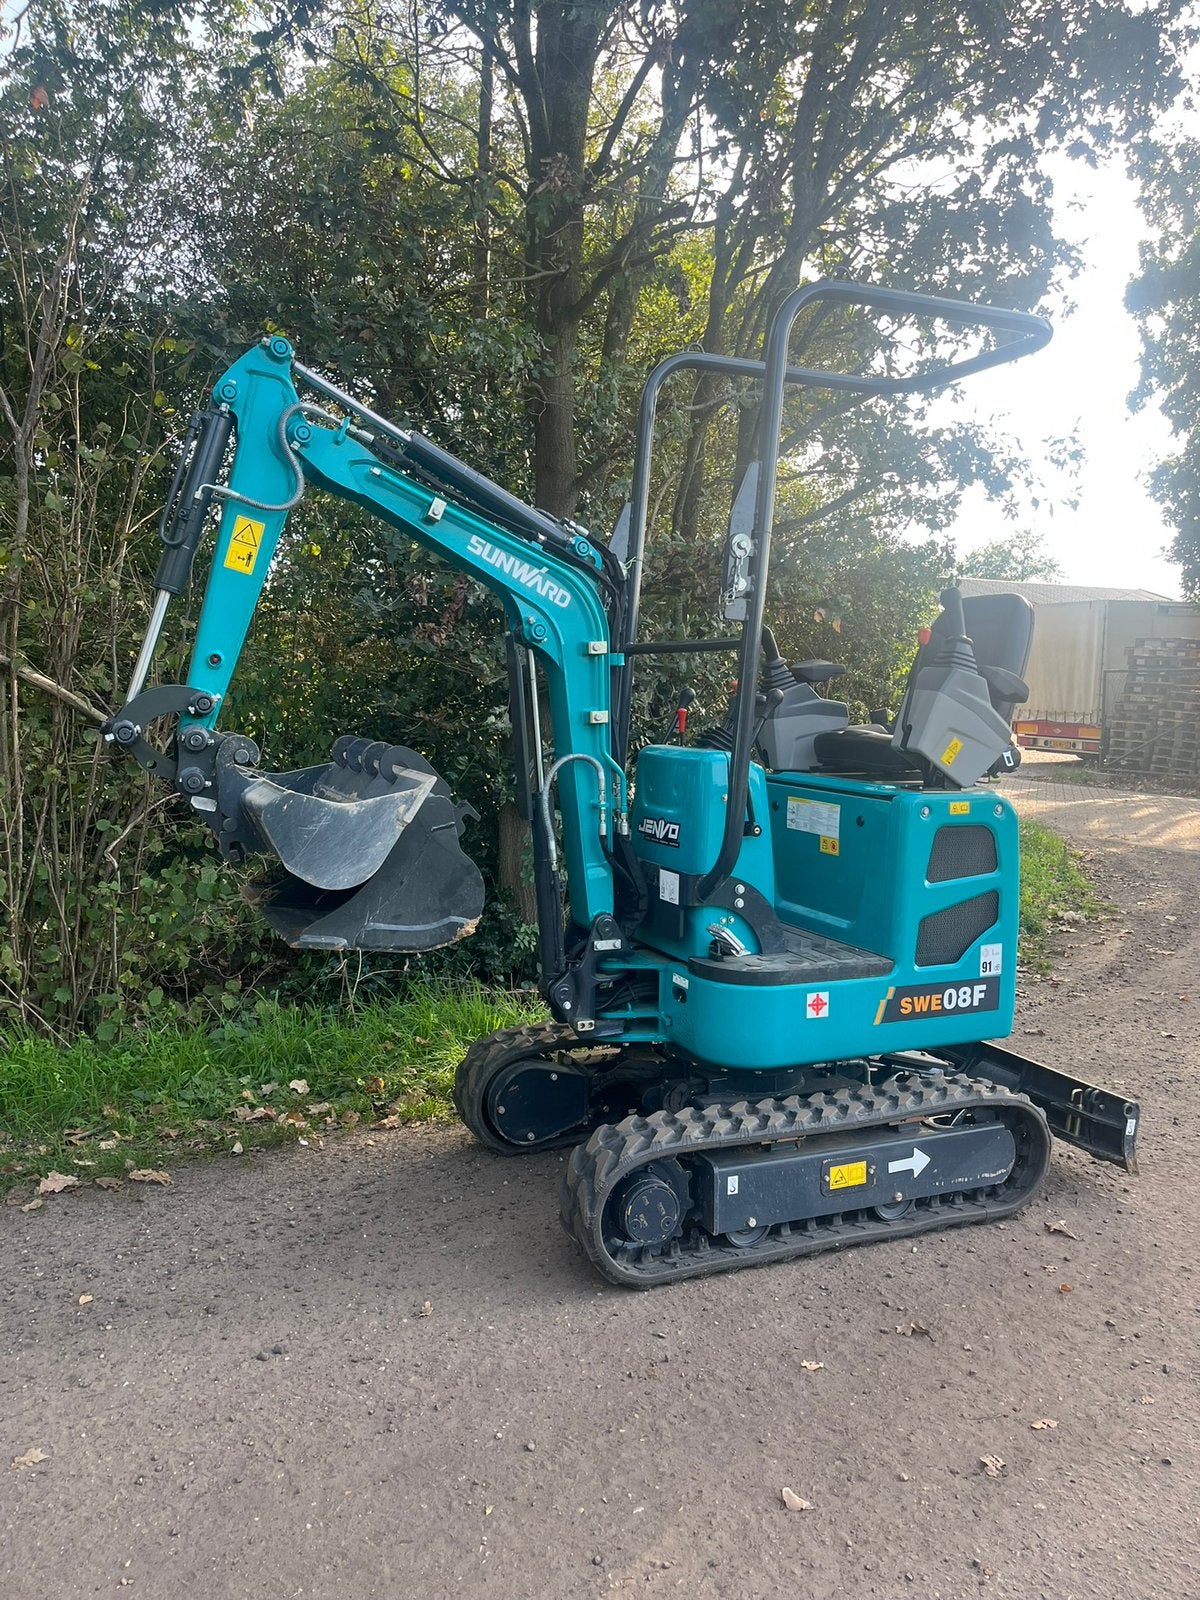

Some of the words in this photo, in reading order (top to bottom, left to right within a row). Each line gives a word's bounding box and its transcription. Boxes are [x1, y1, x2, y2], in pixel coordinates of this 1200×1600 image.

[466, 534, 571, 608] SUNWARD
[638, 818, 680, 839] JENVO
[981, 960, 992, 973] 91
[900, 984, 987, 1015] SWE08F
